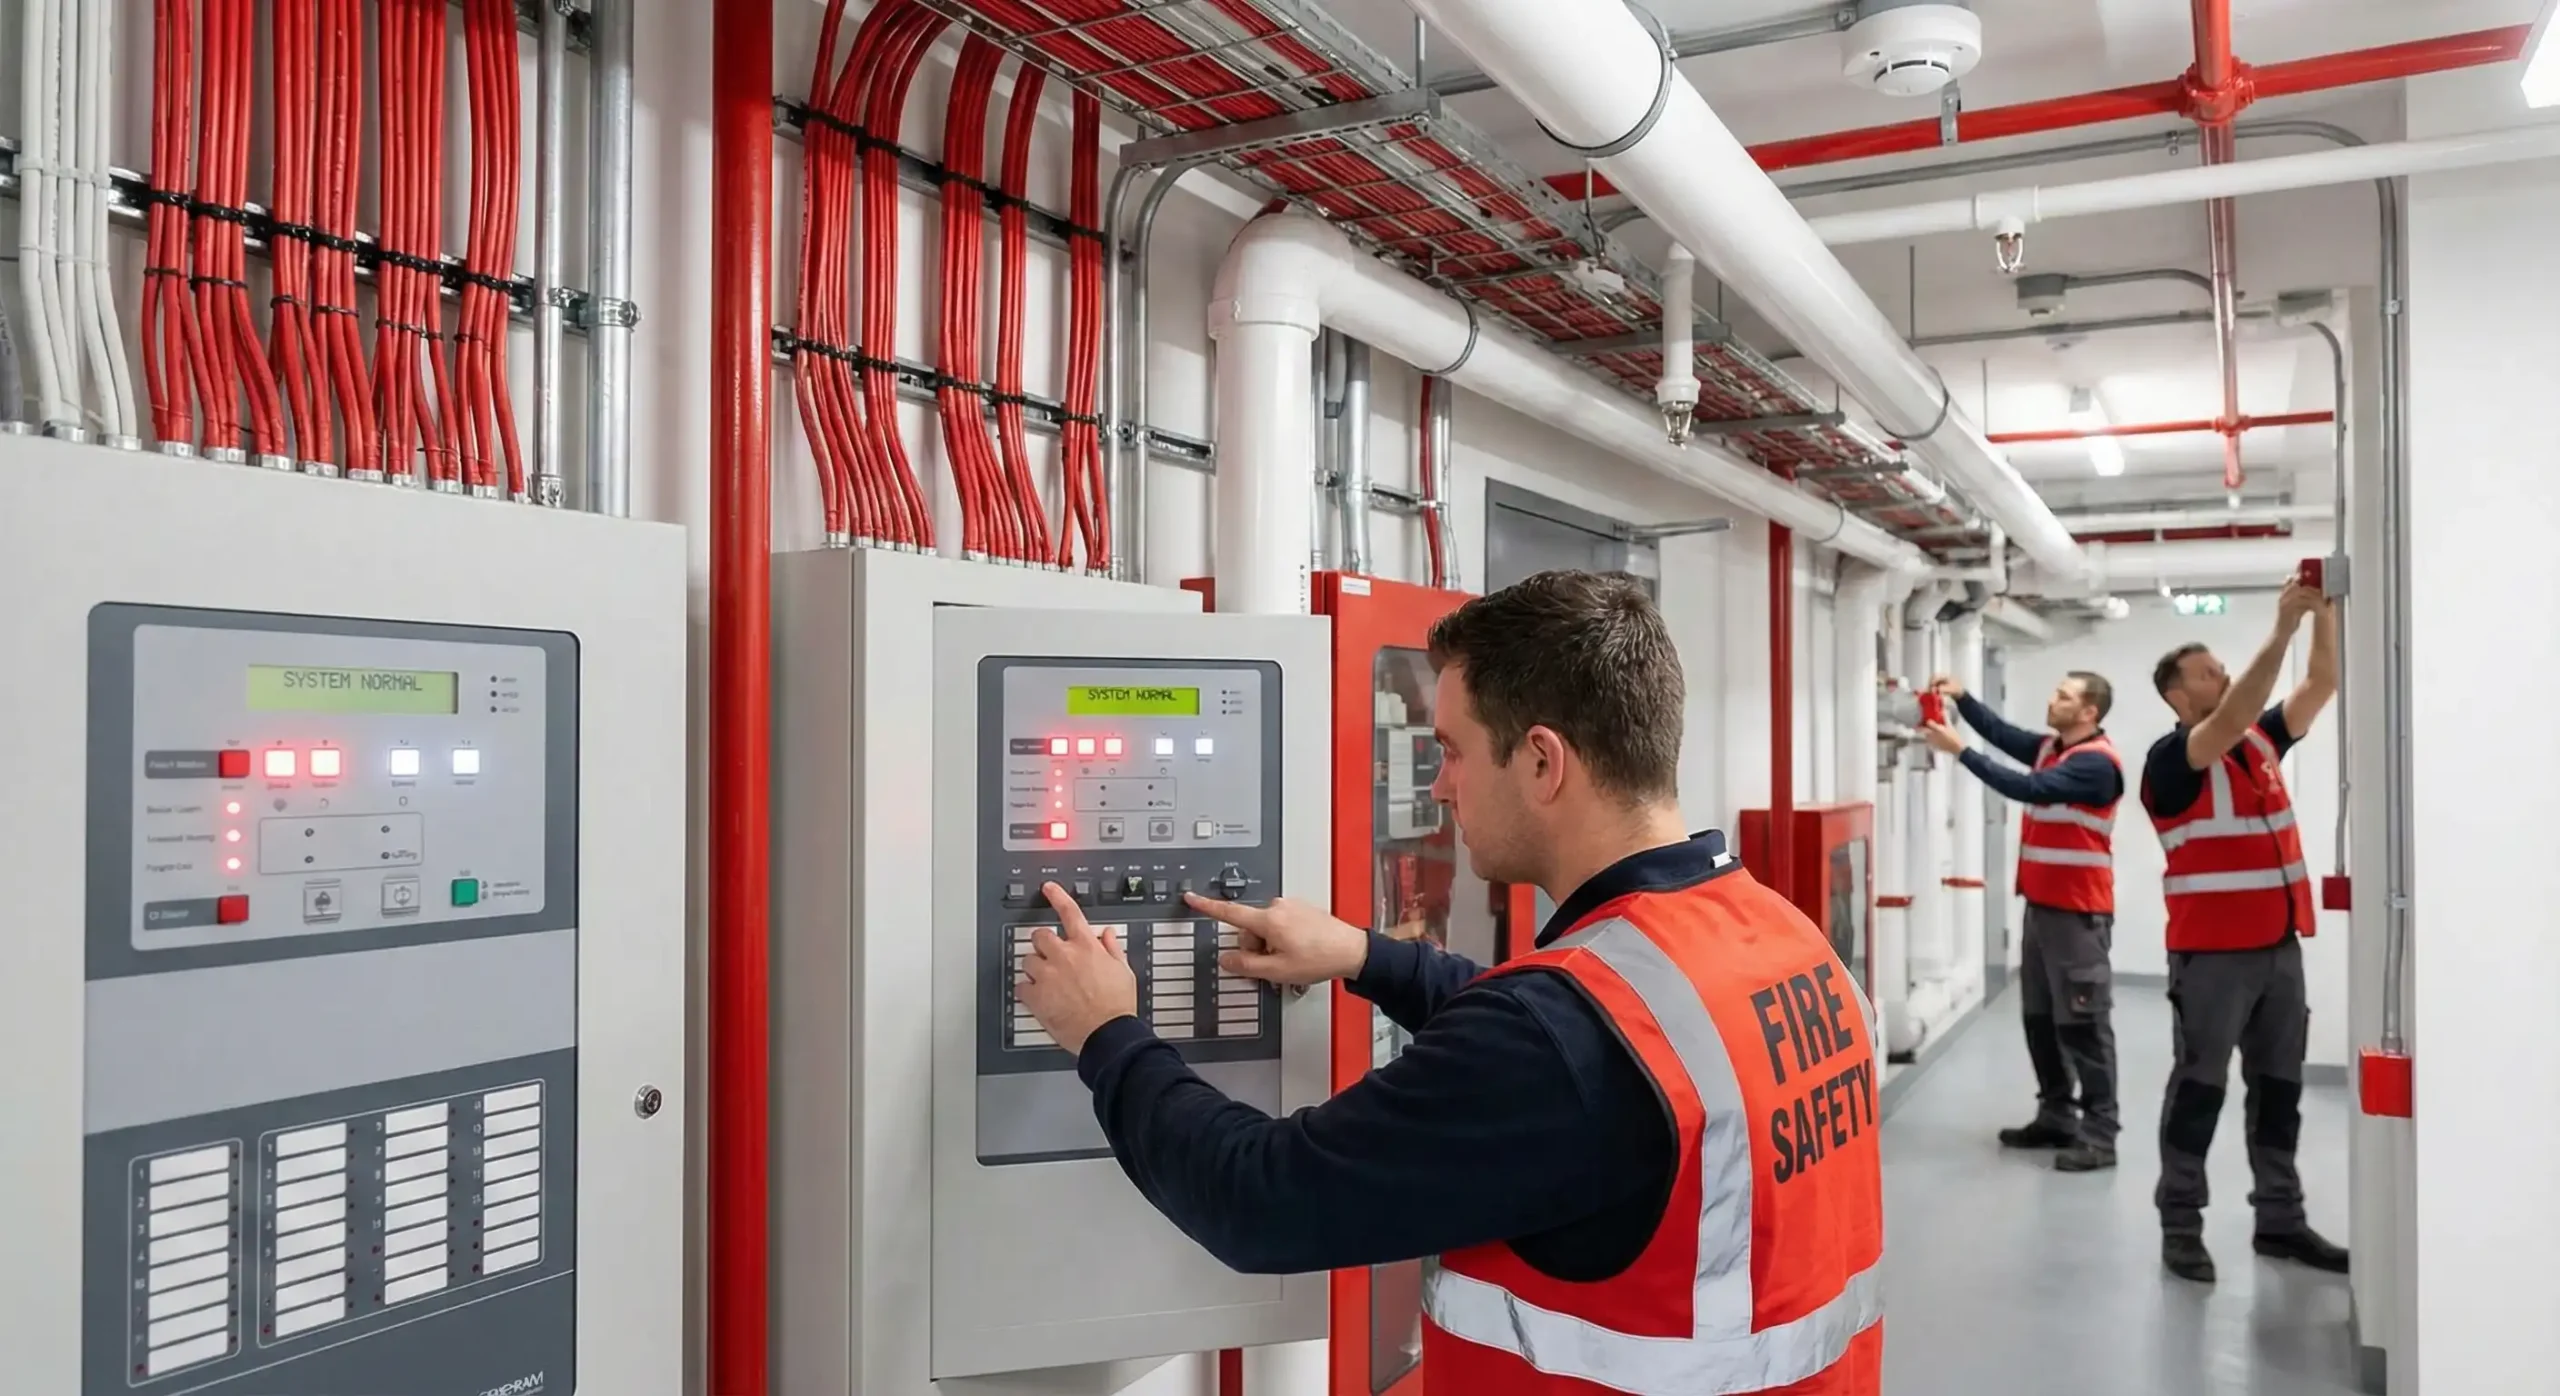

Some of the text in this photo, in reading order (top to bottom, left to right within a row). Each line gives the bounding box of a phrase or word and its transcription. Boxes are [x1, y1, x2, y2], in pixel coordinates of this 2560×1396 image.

[283, 670, 423, 692] SYSTEM NORMAL
[1087, 687, 1177, 701] SYSTEM NORMAL
[1750, 961, 1854, 1086] FIRE
[1770, 1058, 1873, 1185] SAFETY
